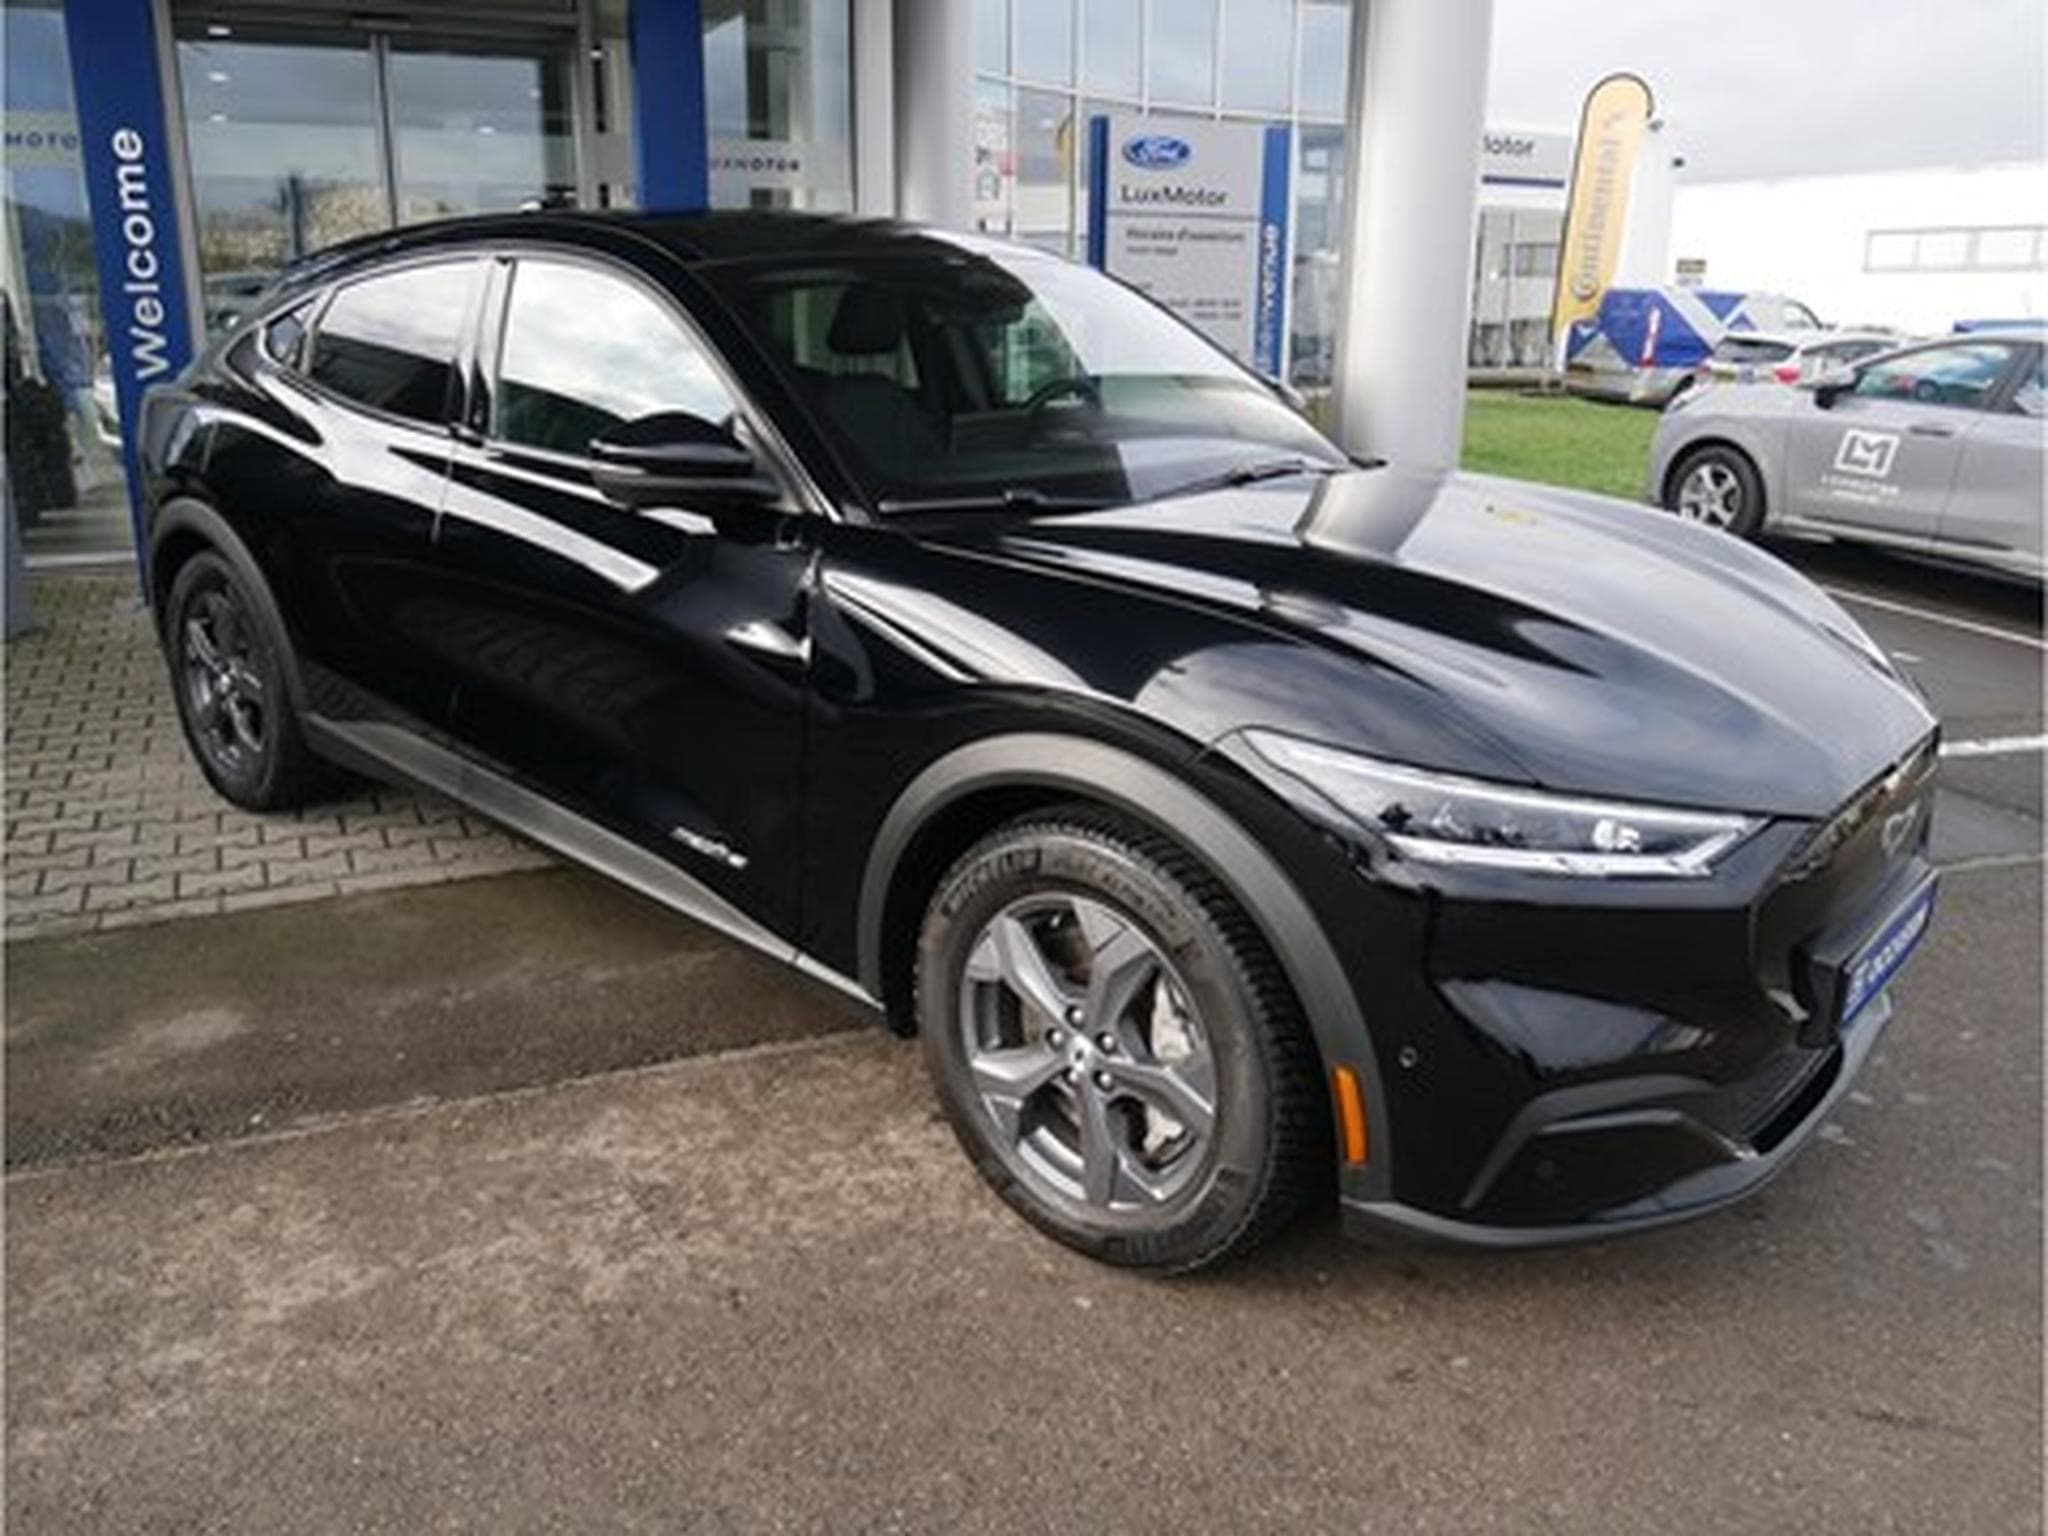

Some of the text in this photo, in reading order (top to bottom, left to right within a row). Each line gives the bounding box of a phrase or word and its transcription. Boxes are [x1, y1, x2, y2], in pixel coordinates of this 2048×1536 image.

[112, 128, 170, 380] Welcome
[1121, 184, 1228, 206] LuxMotor
[1570, 138, 1622, 302] Continental
